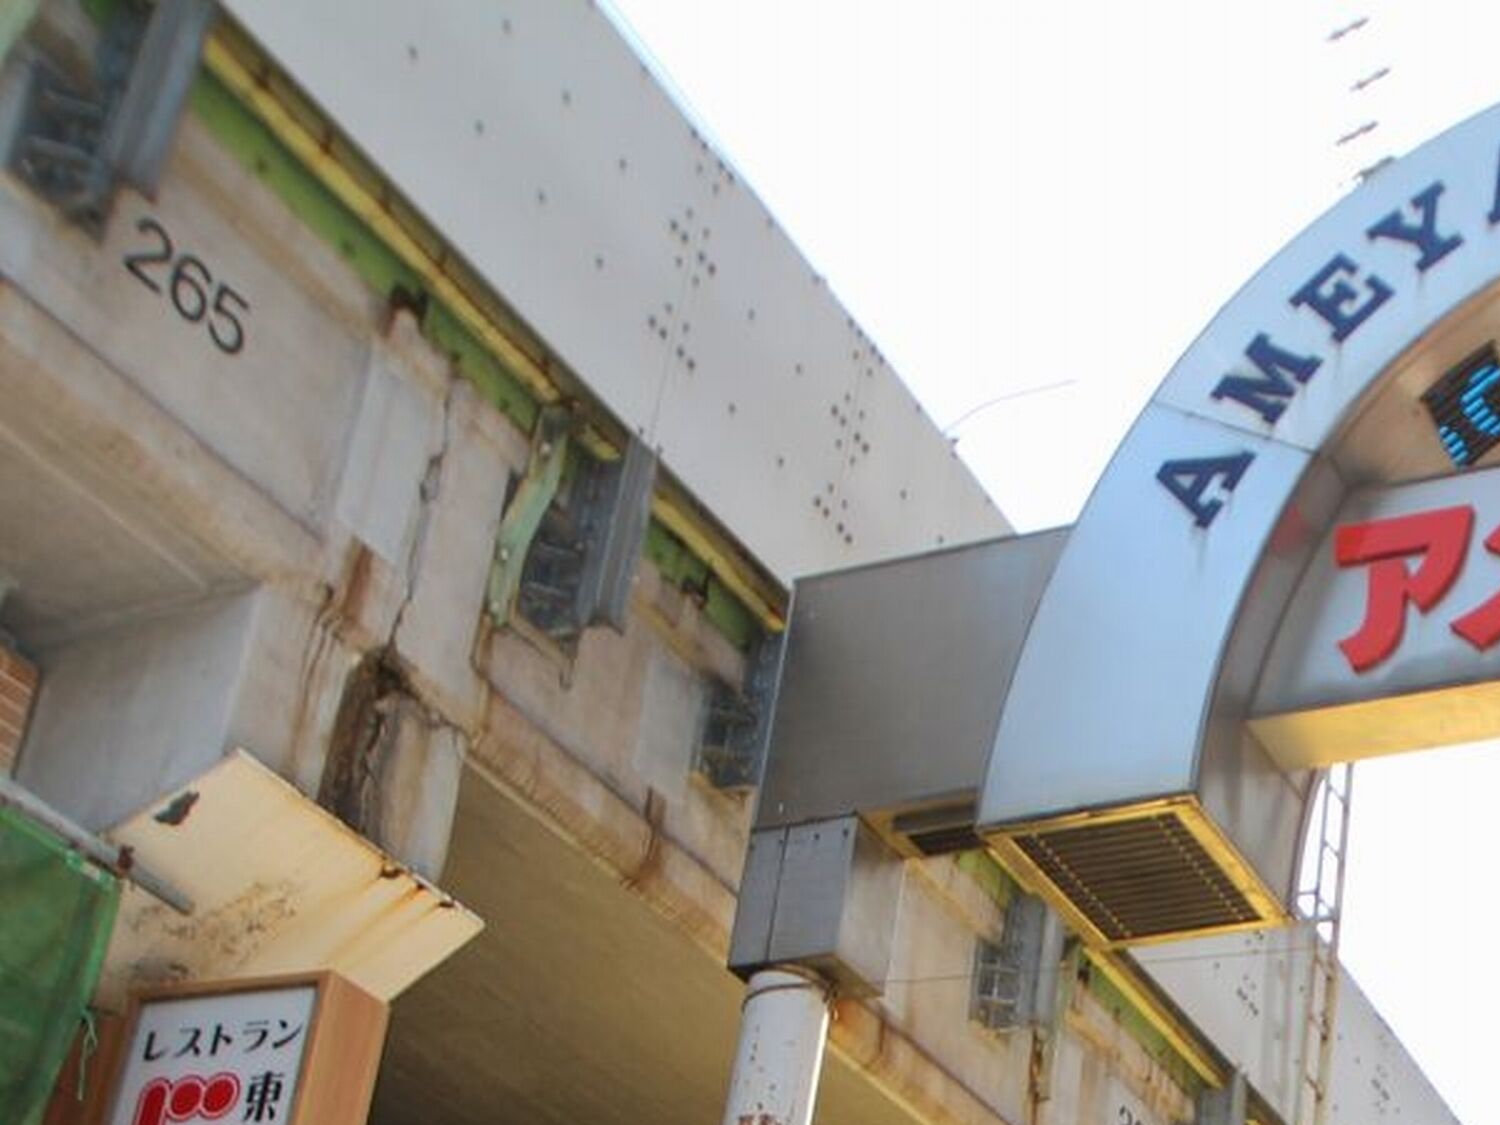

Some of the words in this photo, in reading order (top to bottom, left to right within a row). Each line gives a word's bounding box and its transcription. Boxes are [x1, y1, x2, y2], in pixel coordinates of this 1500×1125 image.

[123, 218, 249, 355] 265
[142, 1019, 302, 1062] レストラン
